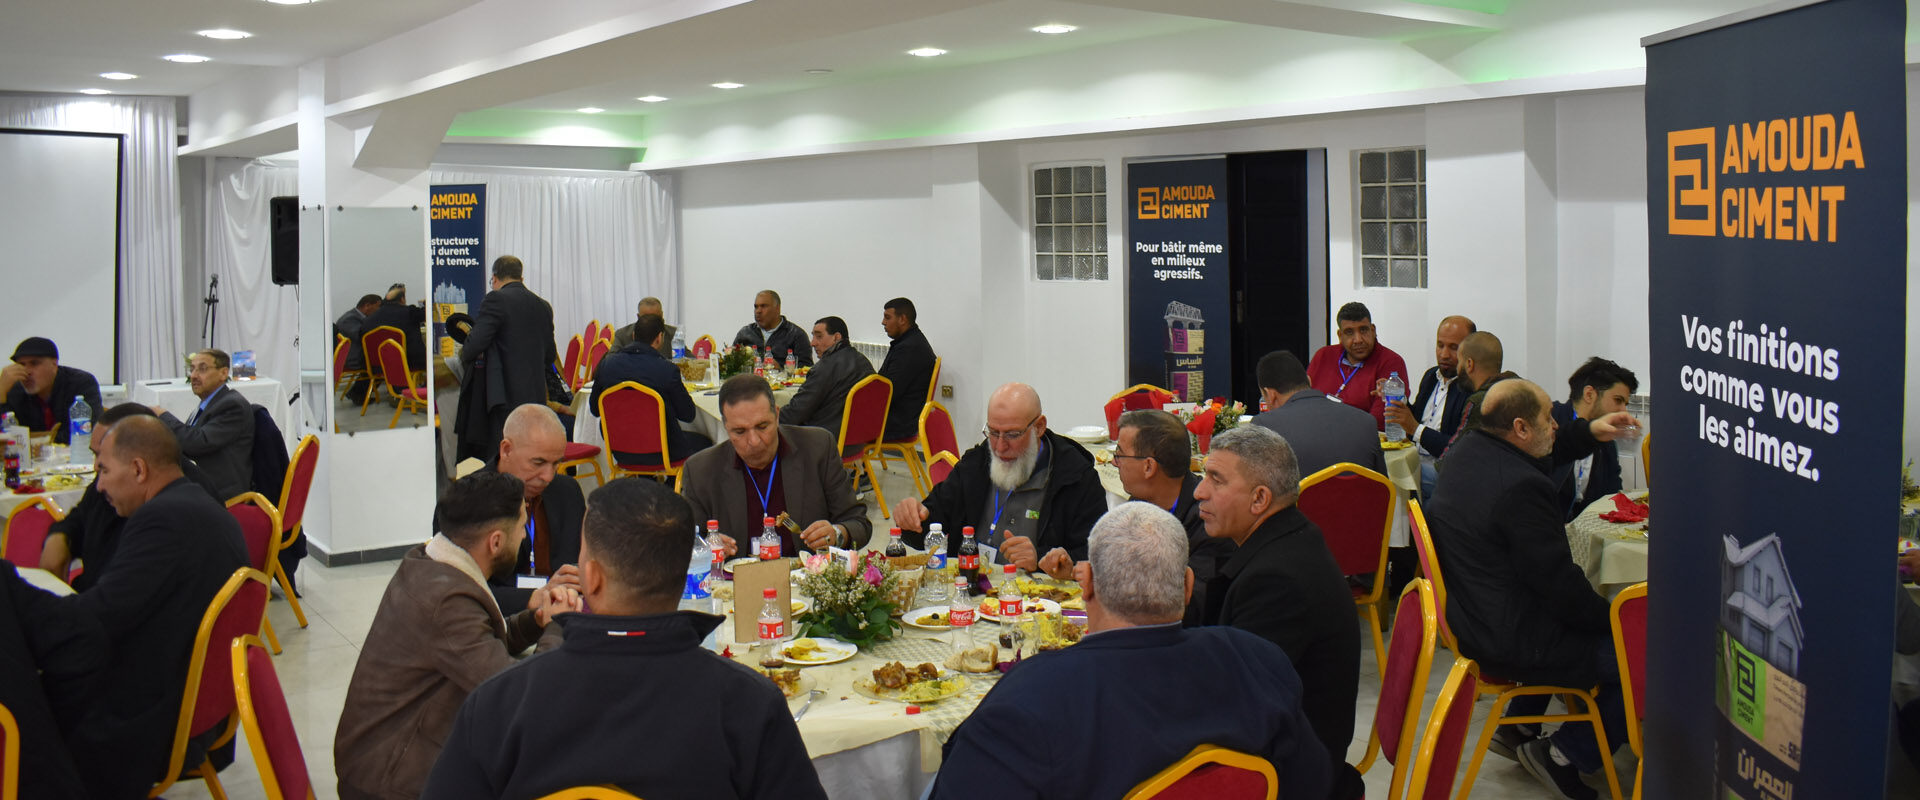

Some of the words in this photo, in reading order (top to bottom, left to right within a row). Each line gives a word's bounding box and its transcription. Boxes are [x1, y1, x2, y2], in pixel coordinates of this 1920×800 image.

[1722, 111, 1865, 174] AMOUDA
[431, 193, 478, 206] AMOUDA
[1162, 185, 1215, 201] AMOUDA
[431, 207, 473, 219] CIMENT
[1161, 203, 1210, 219] CIMENT
[1722, 186, 1845, 242] CIMENT
[438, 247, 470, 256] durent
[1136, 242, 1159, 253] Pour
[1161, 241, 1186, 253] bâtir
[1188, 241, 1223, 253] même
[436, 257, 445, 266] le
[446, 257, 479, 267] temps.
[1151, 256, 1165, 266] en
[1167, 254, 1206, 266] milieux
[1153, 268, 1203, 281] agressifs.
[1681, 315, 1723, 355] Vos
[1727, 319, 1840, 381] finitions
[1680, 364, 1765, 413] comme
[1771, 387, 1840, 434] vous
[1698, 404, 1730, 449] les
[1734, 416, 1820, 482] aimez.
